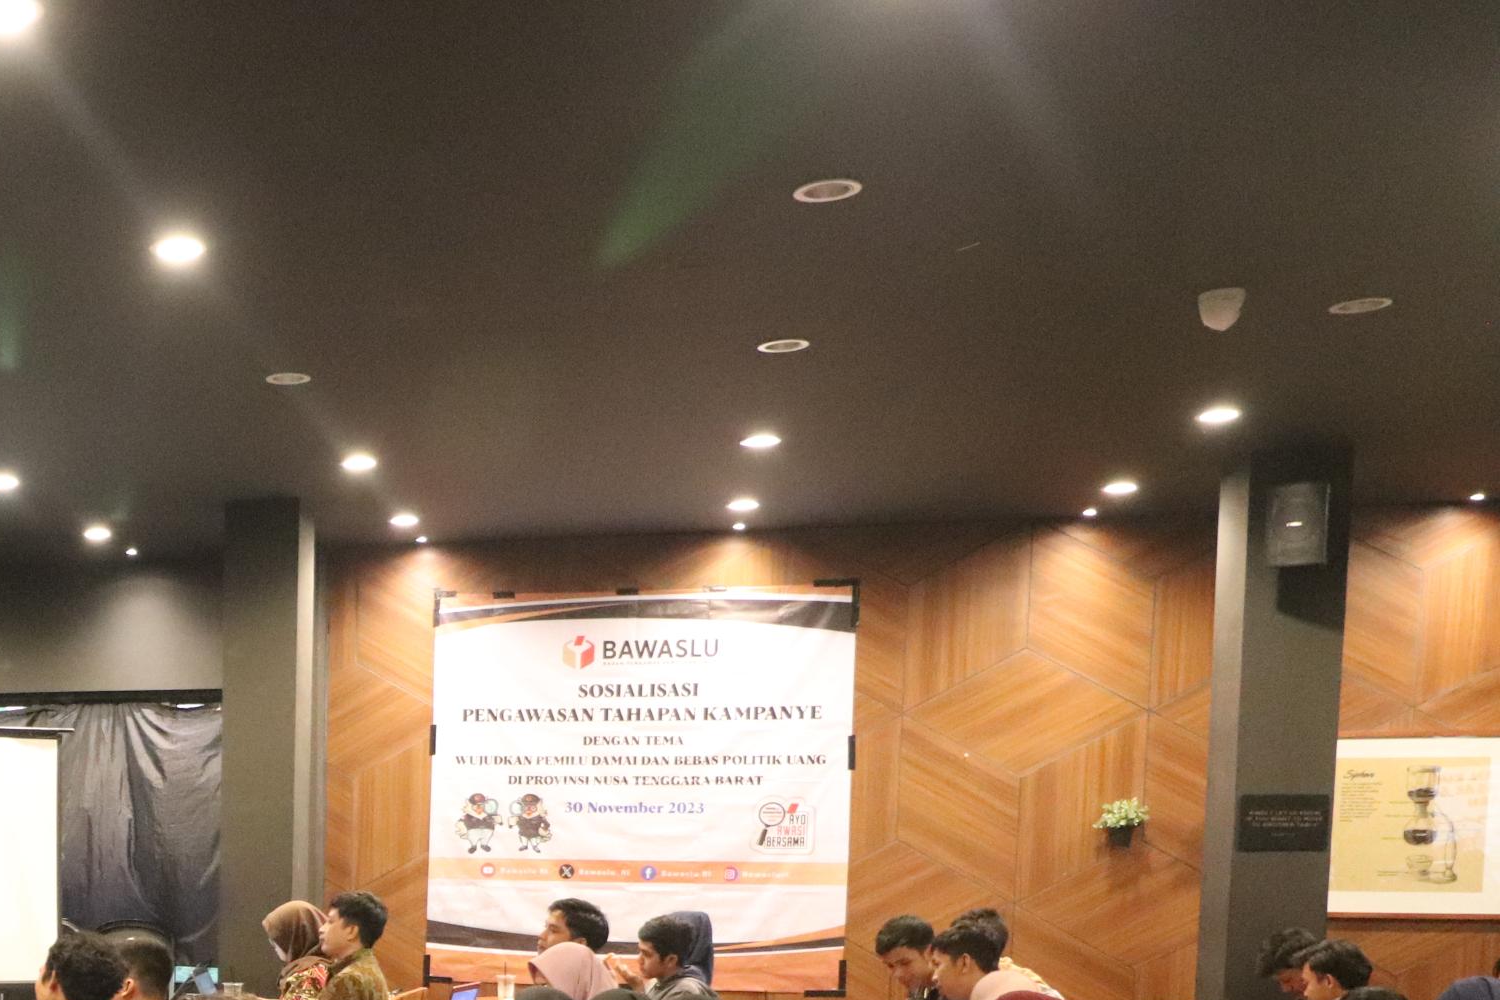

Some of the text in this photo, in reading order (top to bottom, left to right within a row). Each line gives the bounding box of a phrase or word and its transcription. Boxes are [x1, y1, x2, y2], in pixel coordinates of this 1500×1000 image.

[602, 638, 719, 659] BAWASLU
[578, 682, 699, 698] SOSIALISASI
[462, 705, 823, 722] PENGAWASAN TAHAPAN KAMPANYE
[583, 735, 684, 746] DENGAN TEMA
[455, 754, 827, 766] WUJUDKAN PEMILU DAMAI DAN BEBAS POLITIK UANG
[508, 775, 764, 786] DI PROVINSI NUSA TENGGARA BARAT
[564, 801, 705, 814] 30 November 2023
[766, 836, 805, 847] BERSAMA
